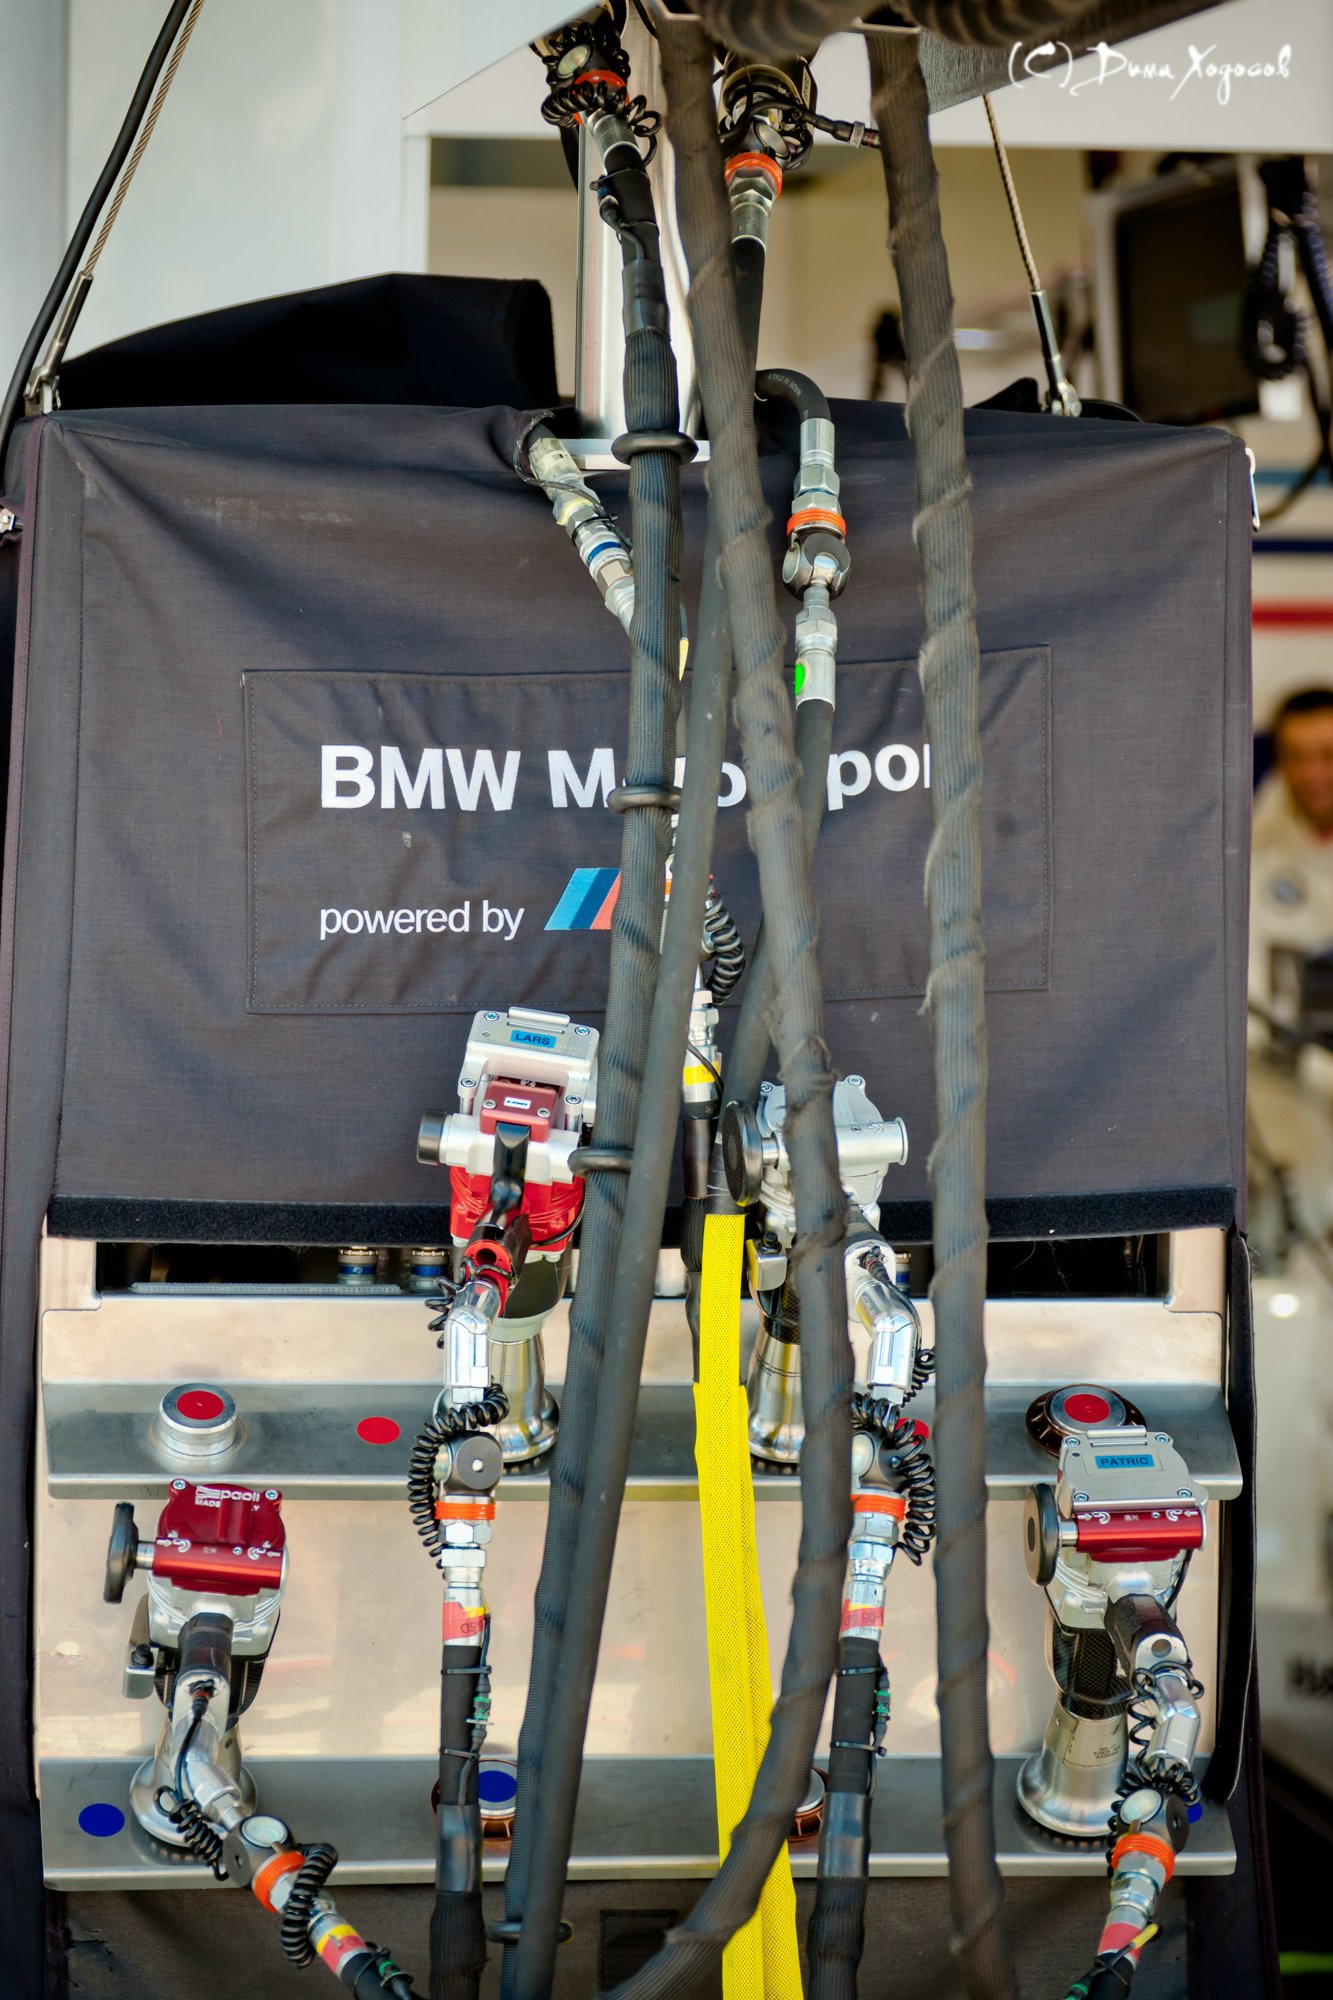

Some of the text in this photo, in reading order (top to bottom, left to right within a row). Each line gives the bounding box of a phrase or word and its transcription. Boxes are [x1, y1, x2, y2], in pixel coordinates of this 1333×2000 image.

[320, 744, 521, 811] BMW
[319, 900, 525, 940] powered by
[515, 1033, 550, 1046] LARS
[1100, 1456, 1149, 1466] PATRIC
[220, 1489, 260, 1503] paoli
[194, 1499, 221, 1508] MADE
